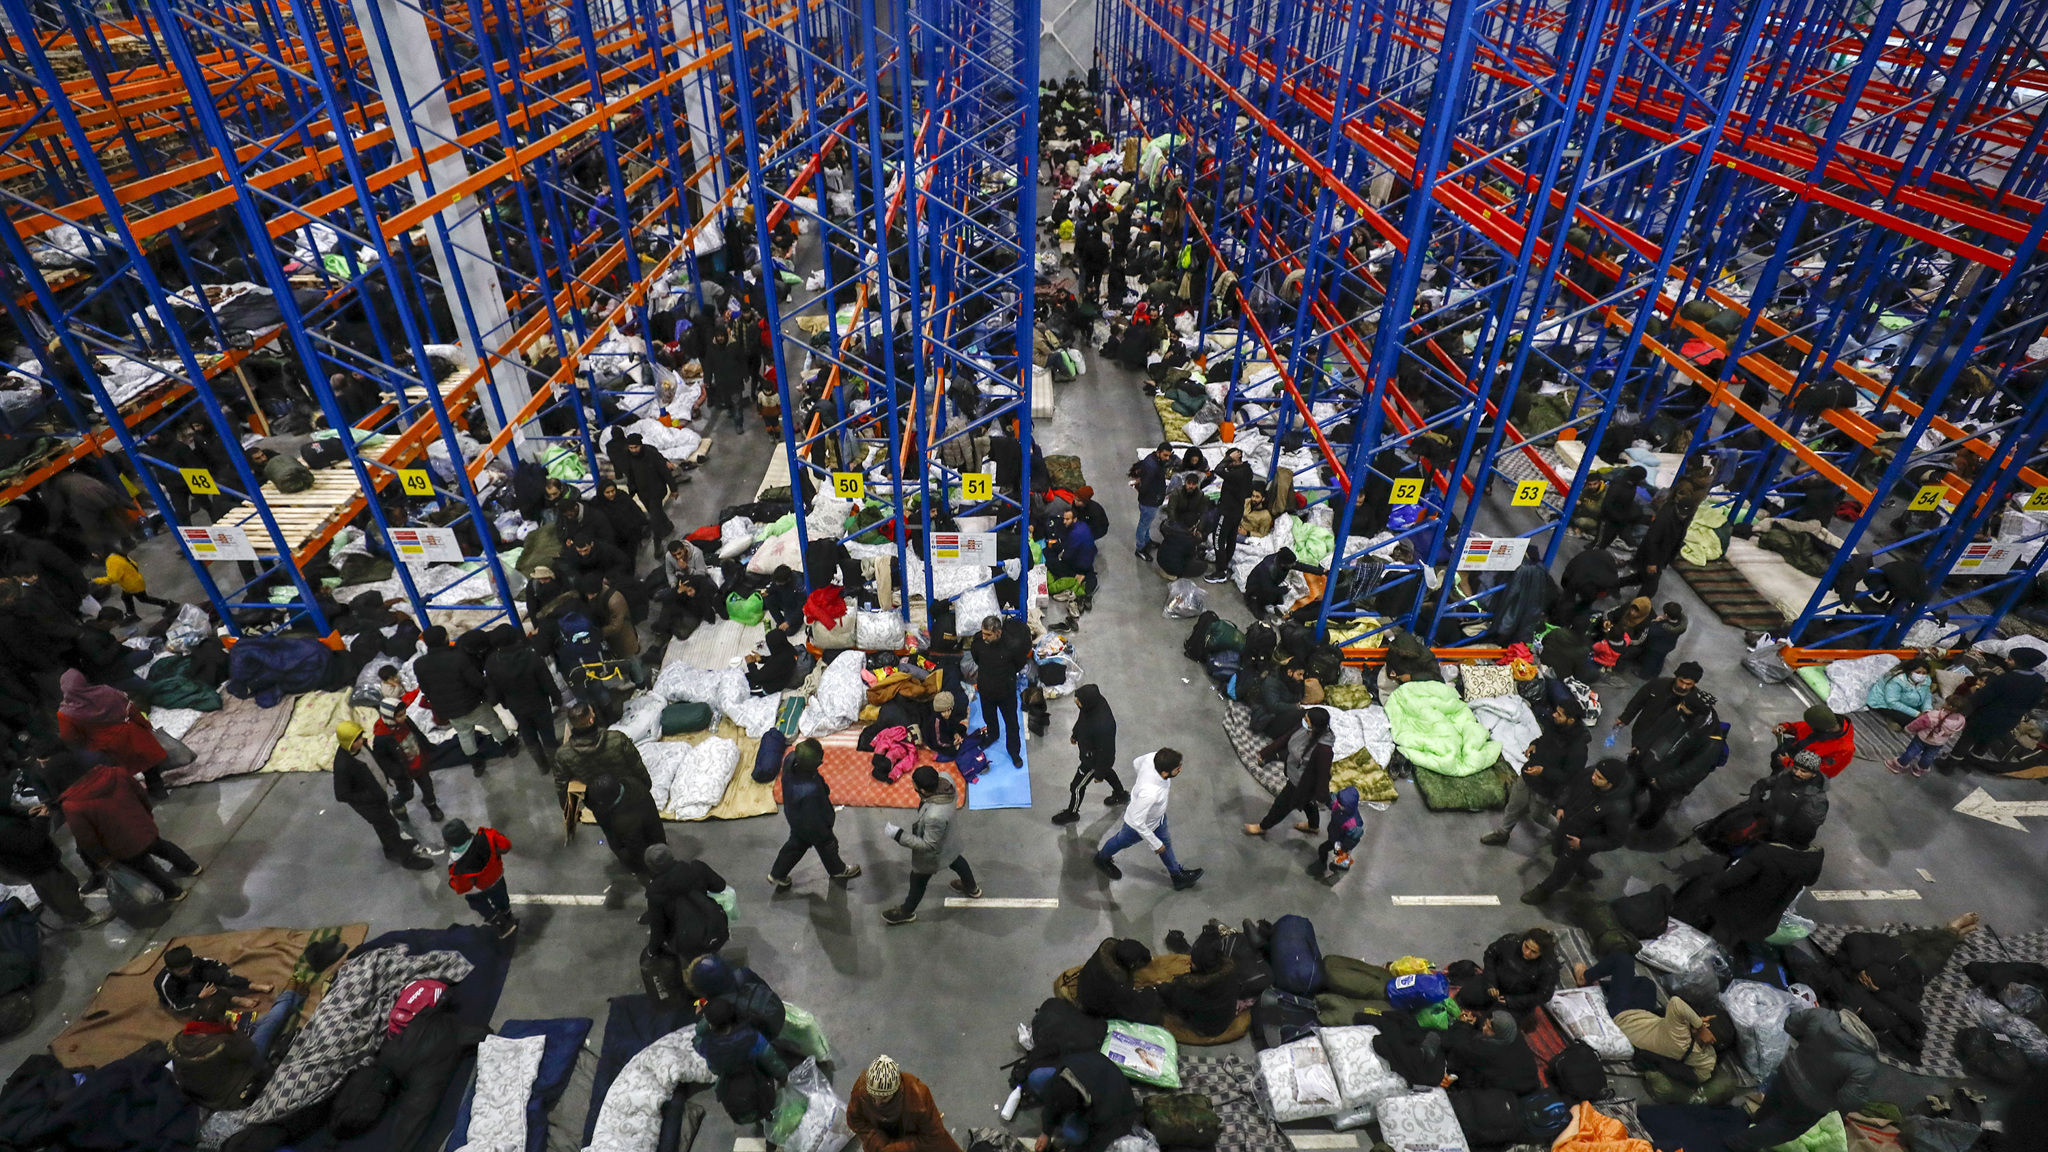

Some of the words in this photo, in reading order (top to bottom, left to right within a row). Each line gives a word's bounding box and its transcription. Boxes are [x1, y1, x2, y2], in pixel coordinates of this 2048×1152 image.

[191, 475, 211, 489] 48
[407, 476, 426, 490] 49
[840, 479, 858, 493] 50
[968, 479, 985, 494] 51
[1396, 484, 1416, 498] 52
[1519, 486, 1539, 500] 53
[1917, 492, 1940, 505] 54
